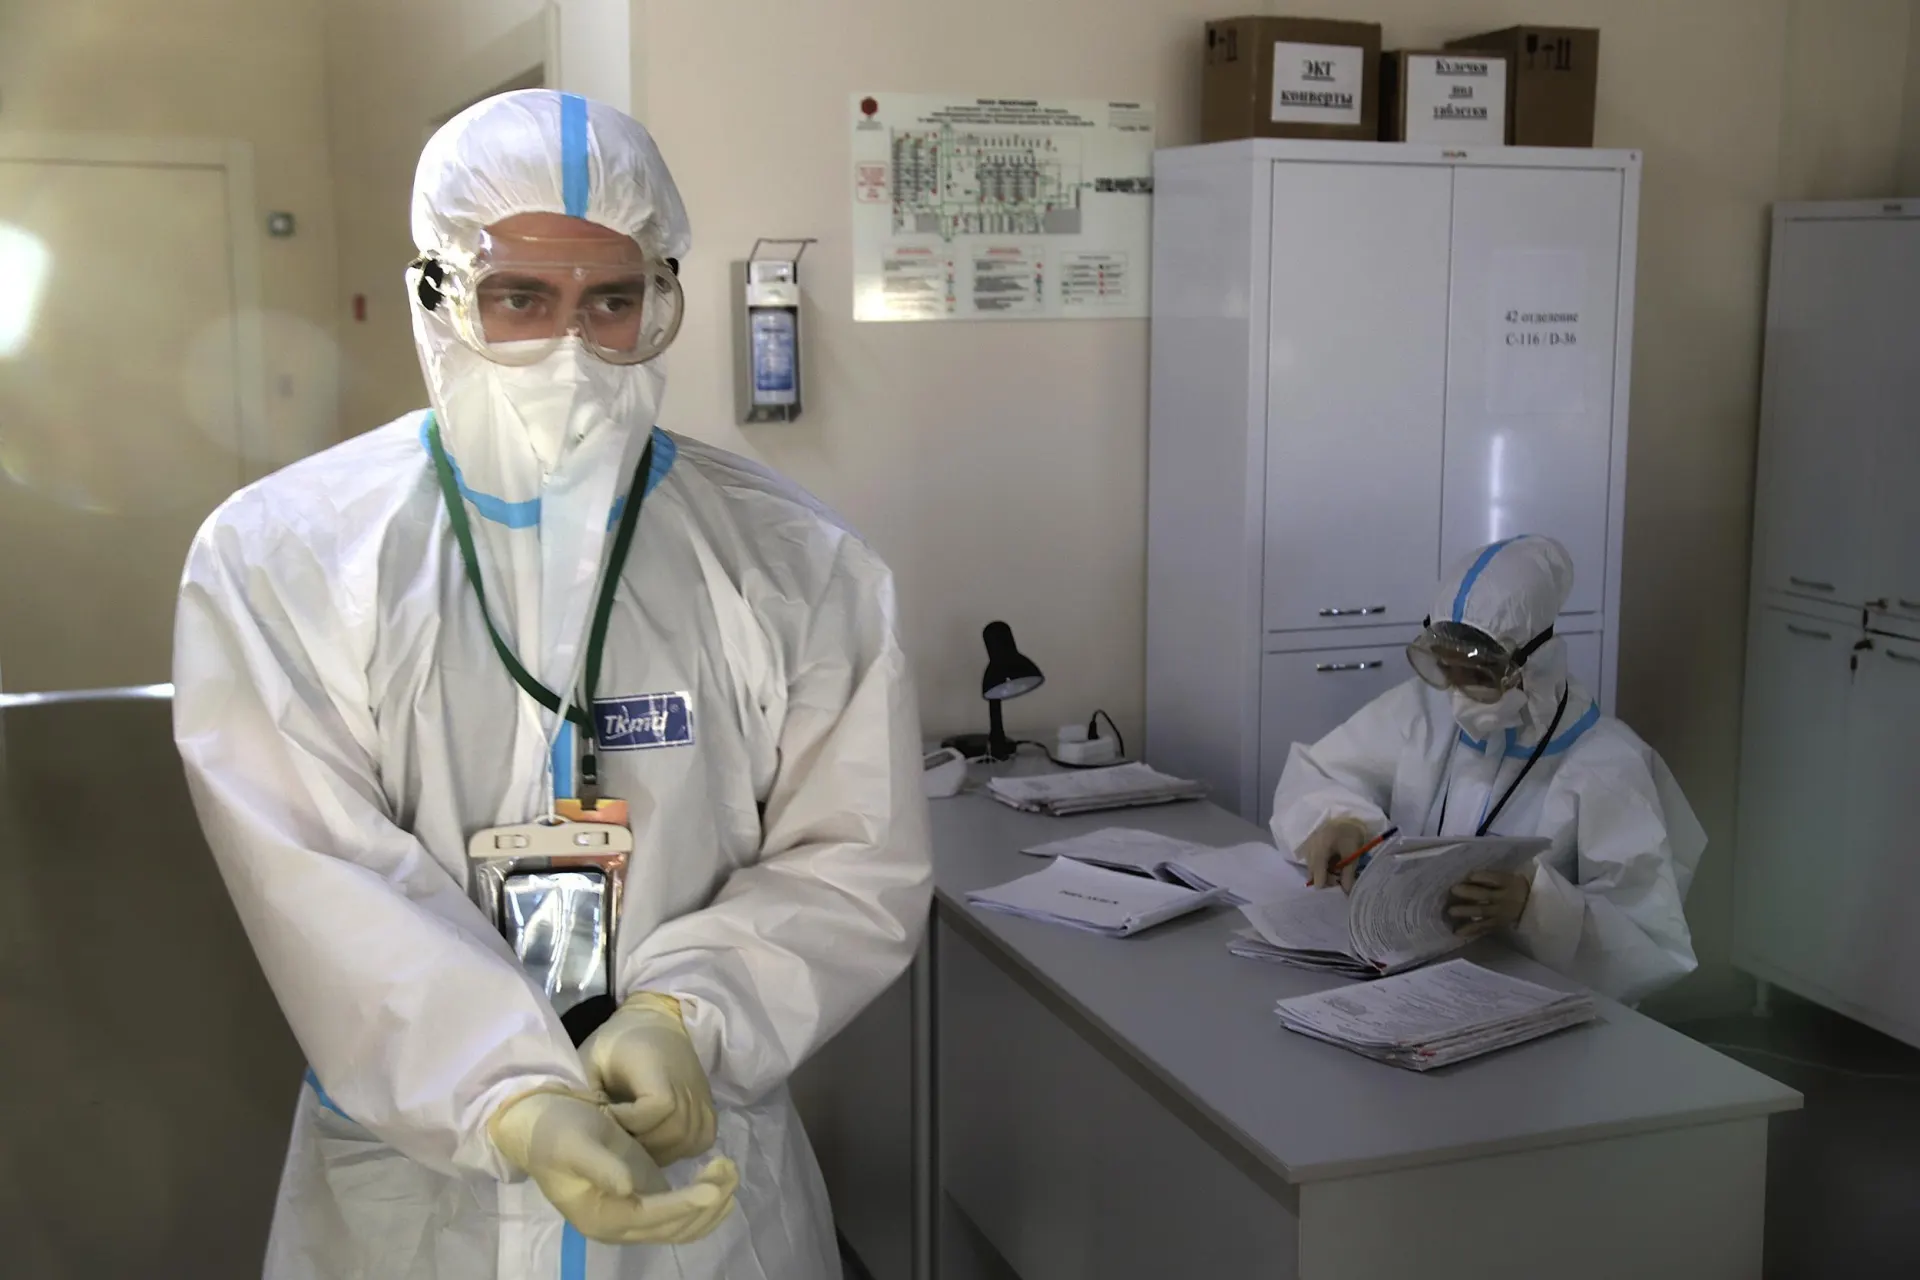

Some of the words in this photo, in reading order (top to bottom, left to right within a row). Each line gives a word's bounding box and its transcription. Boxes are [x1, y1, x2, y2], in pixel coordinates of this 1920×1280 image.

[1302, 59, 1336, 79] ЭКГ
[1280, 90, 1353, 106] конверты
[1433, 103, 1488, 118] таблетки
[1504, 310, 1519, 323] 42
[1521, 312, 1579, 324] отделение
